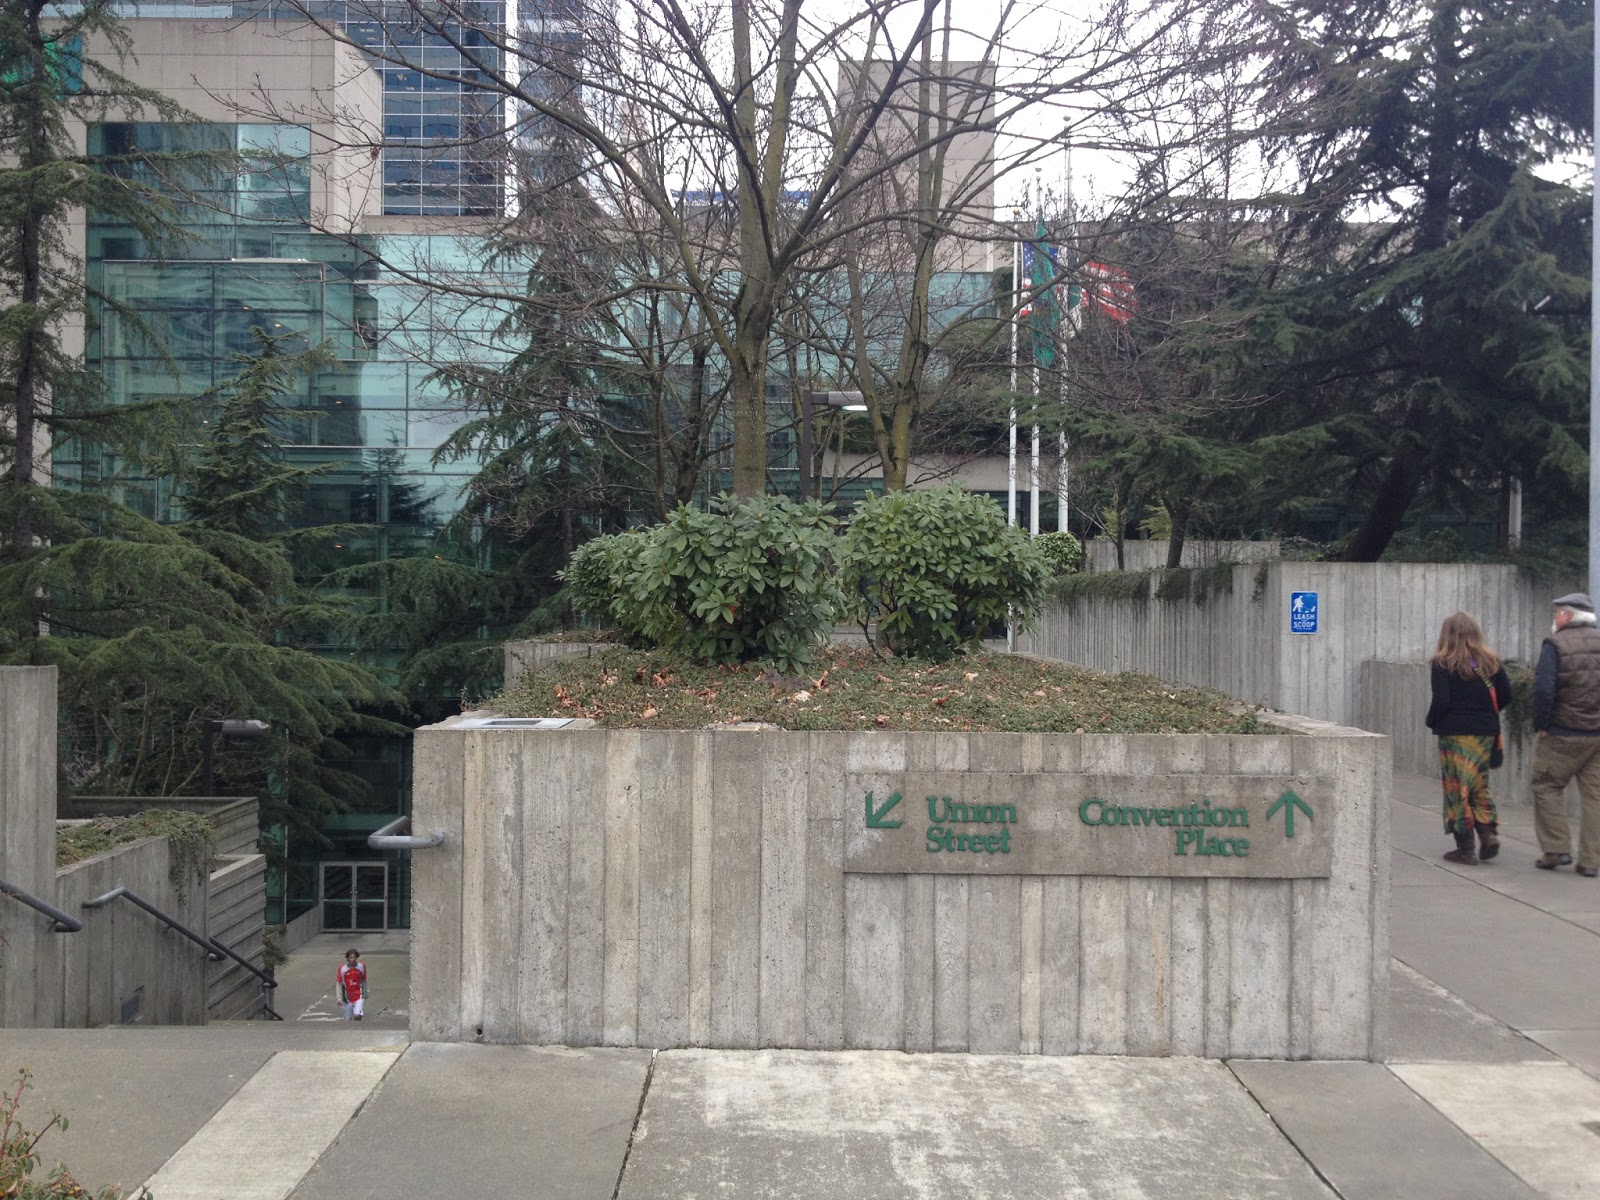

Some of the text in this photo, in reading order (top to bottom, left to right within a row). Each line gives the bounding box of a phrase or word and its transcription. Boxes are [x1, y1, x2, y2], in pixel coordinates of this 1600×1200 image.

[926, 796, 1018, 824] Union
[1079, 799, 1249, 827] Convention
[925, 824, 1011, 853] Street
[1174, 828, 1249, 857] Place
